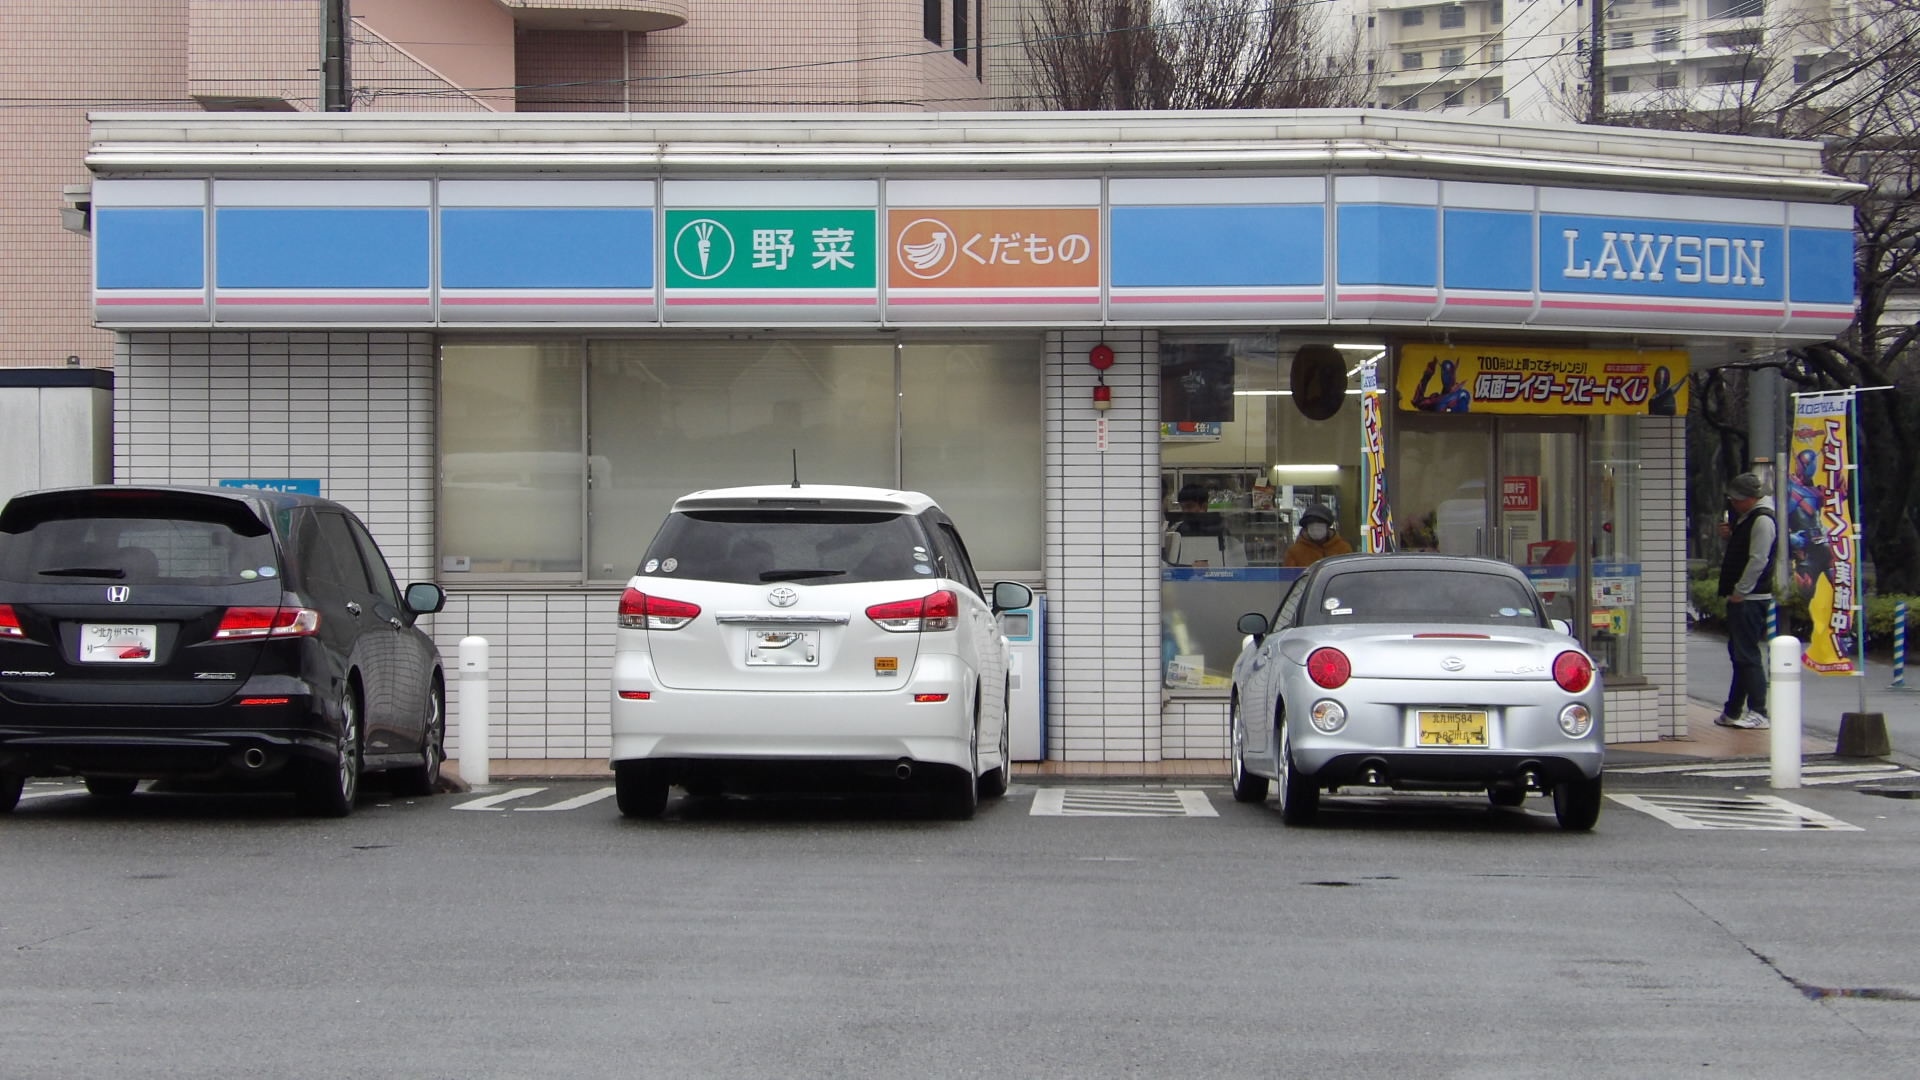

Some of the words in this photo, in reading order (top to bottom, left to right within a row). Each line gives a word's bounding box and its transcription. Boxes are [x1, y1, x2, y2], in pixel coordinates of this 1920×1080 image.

[752, 228, 855, 270] 野菜
[962, 232, 1091, 265] くだもの
[1563, 230, 1765, 285] LAWSON
[1474, 373, 1649, 403] 仮面ライダースピードくじ
[1503, 495, 1529, 506] ATM
